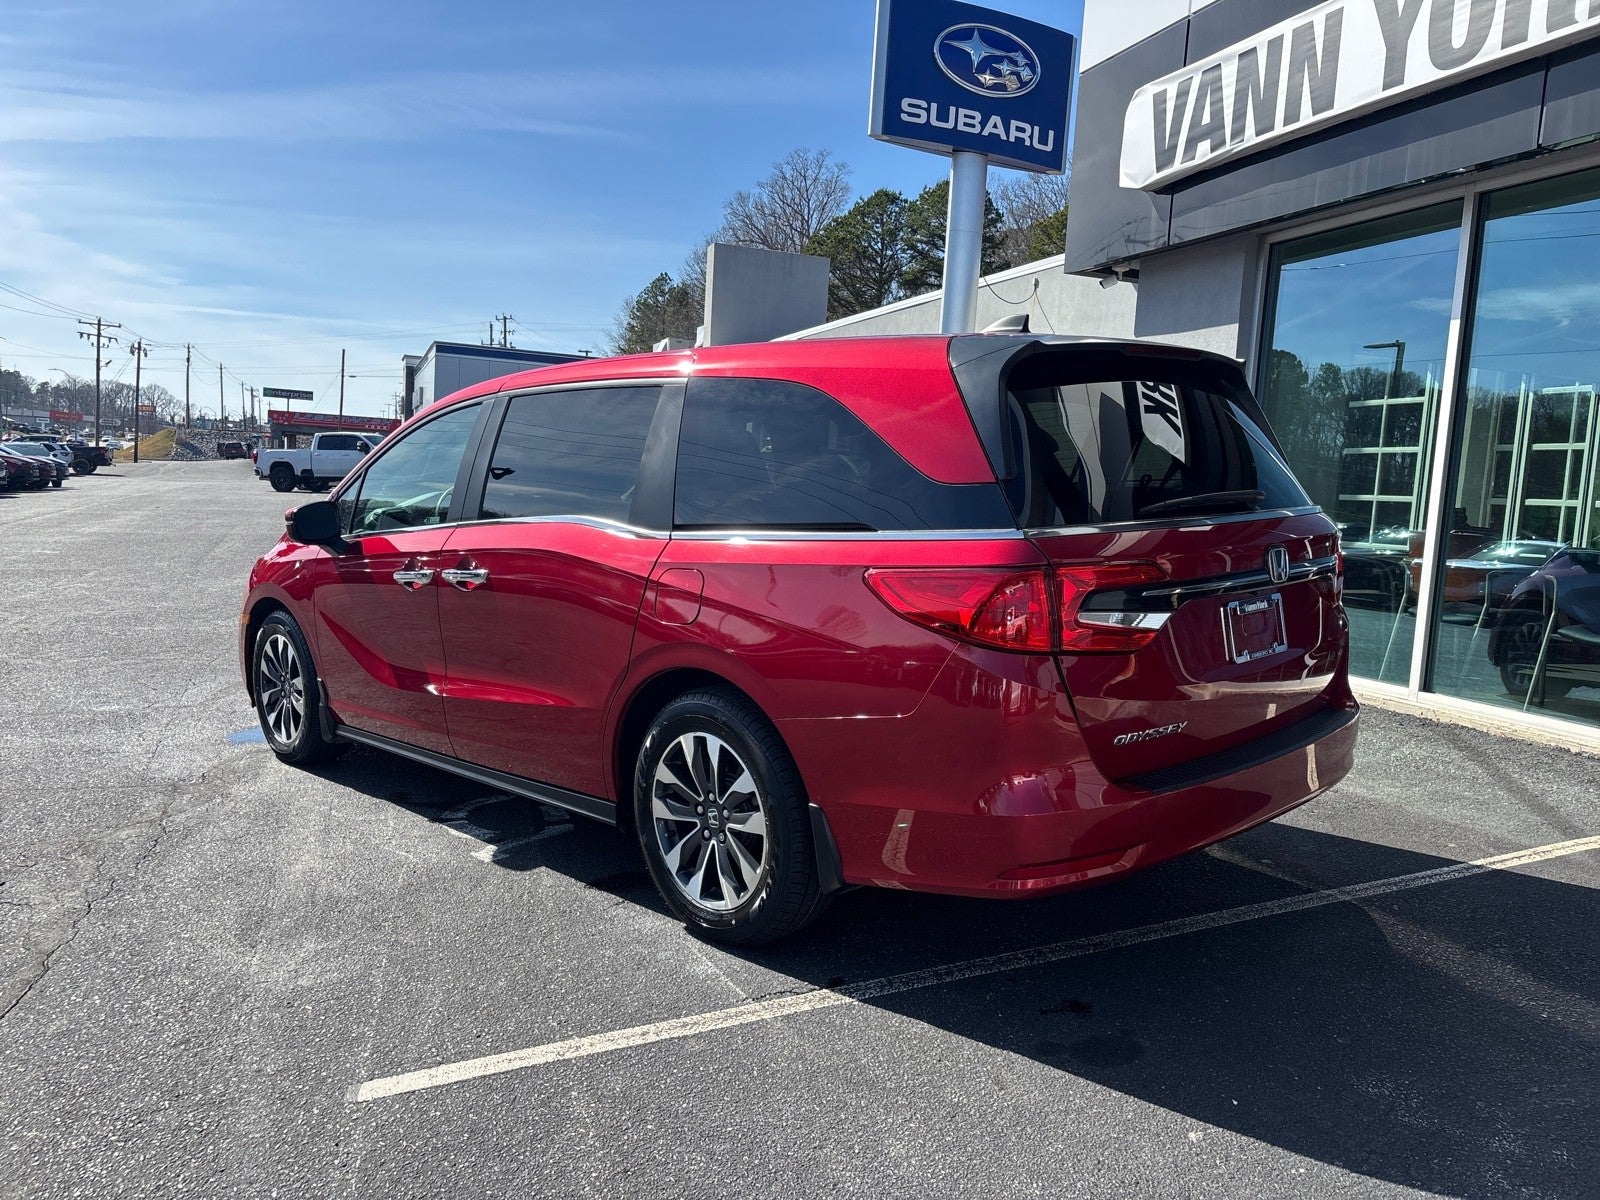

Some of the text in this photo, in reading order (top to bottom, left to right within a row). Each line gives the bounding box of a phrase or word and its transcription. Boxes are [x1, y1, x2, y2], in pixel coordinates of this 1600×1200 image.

[1152, 0, 1600, 174] VANN YO
[900, 97, 1054, 152] SUBARU
[265, 389, 313, 400] enterprise
[1113, 720, 1188, 745] ODYSSEY
